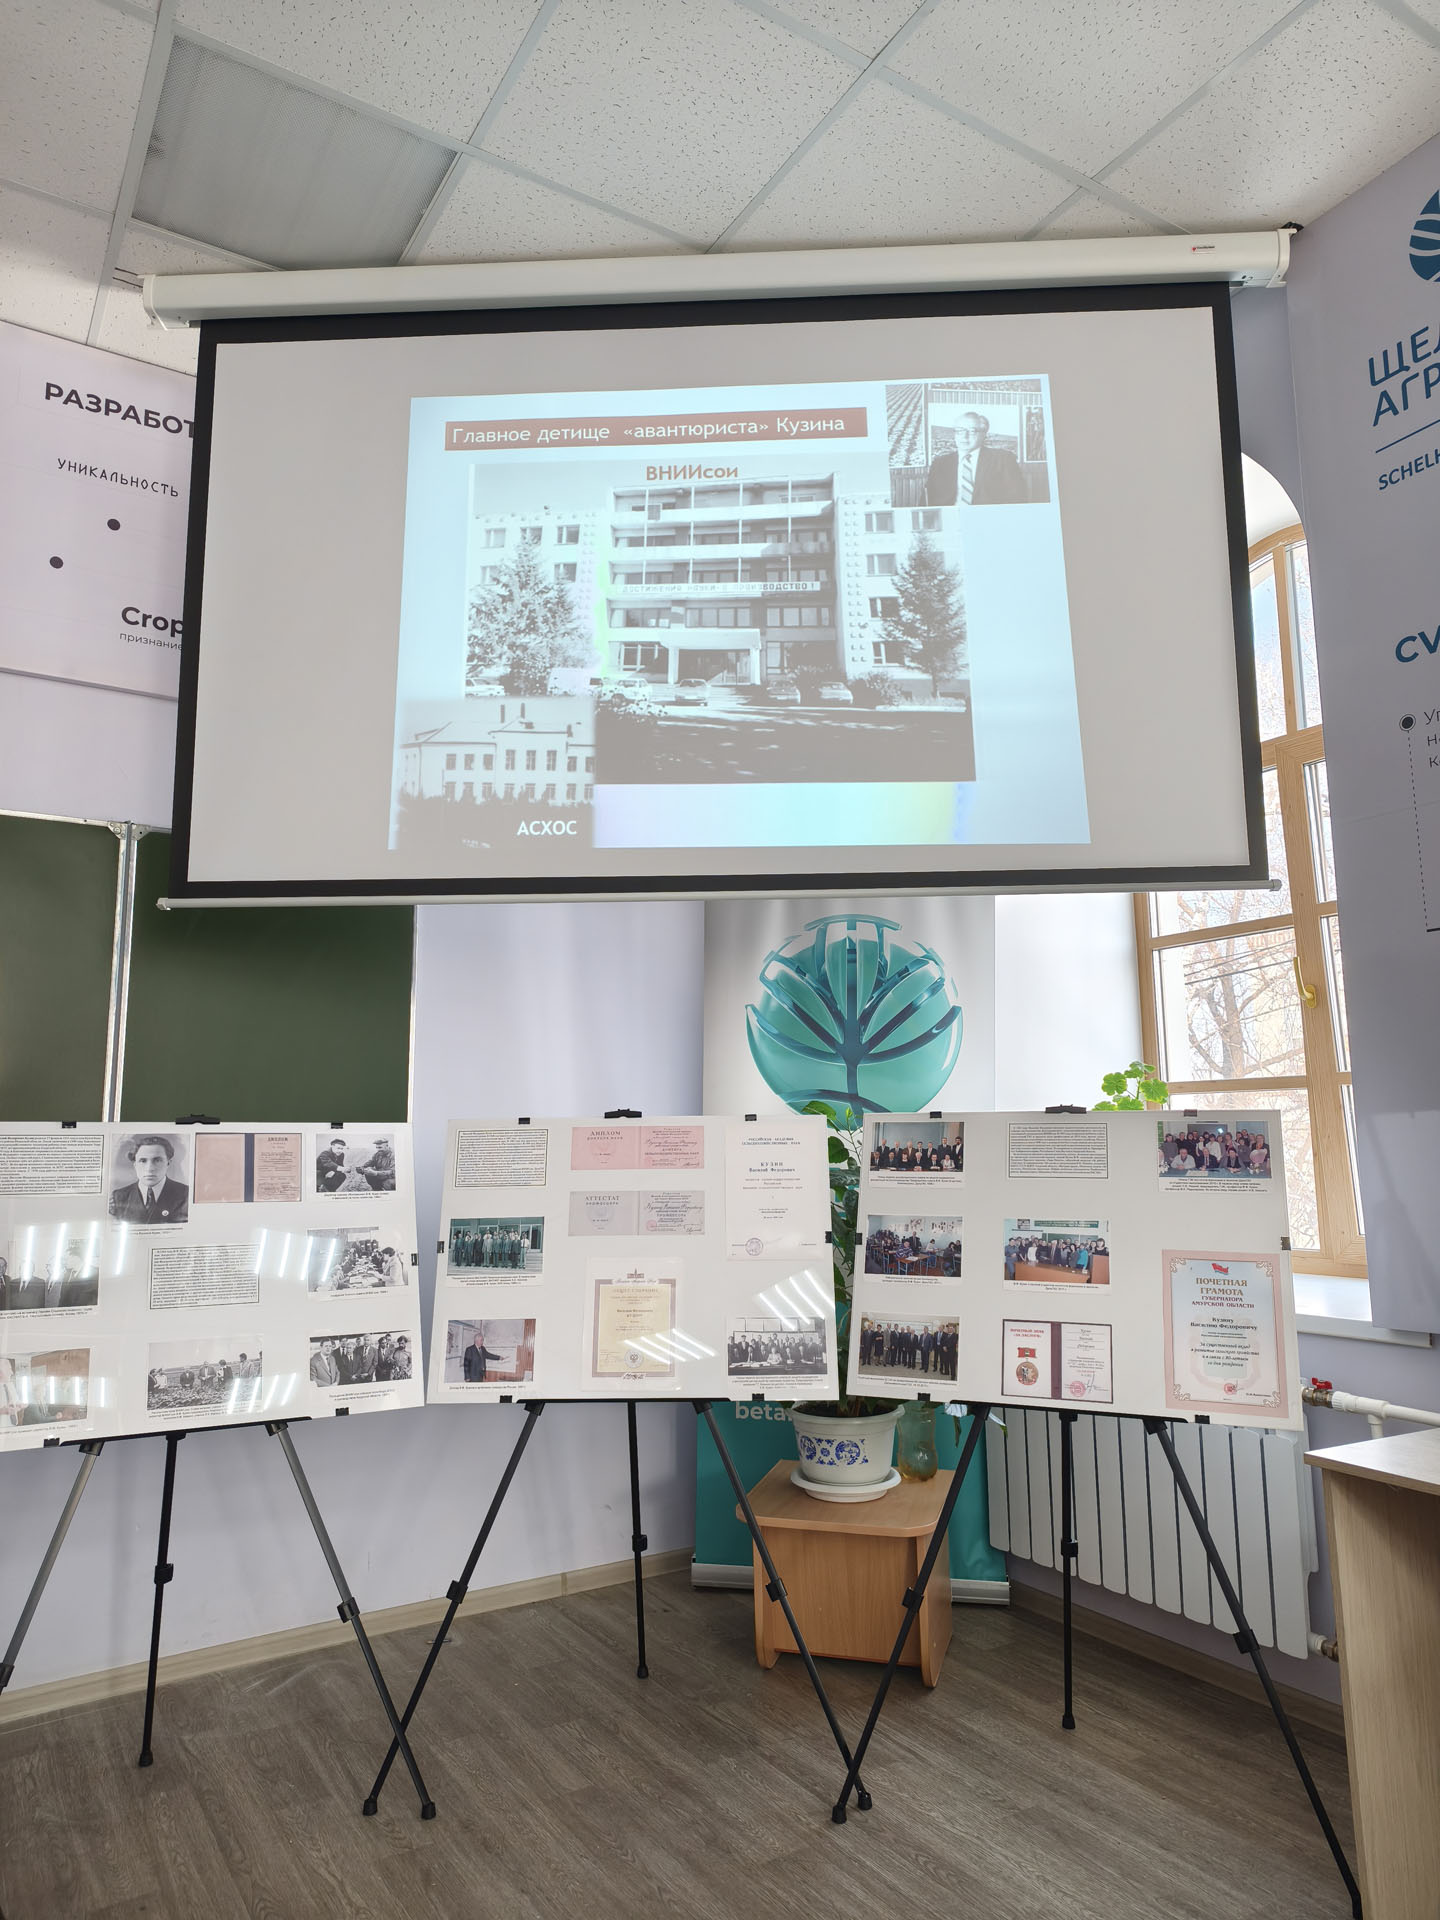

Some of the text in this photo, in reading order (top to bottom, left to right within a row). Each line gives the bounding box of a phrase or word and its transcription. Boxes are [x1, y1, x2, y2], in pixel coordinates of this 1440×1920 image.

[453, 417, 846, 443] Главное детище «авантюриста» Кузина
[57, 458, 179, 497] УНИКАЛЬНОСТЬ
[646, 464, 739, 481] ВНИИсои
[517, 820, 577, 836] АСХОС
[1196, 1277, 1248, 1287] ПОЧЕТНАЯ
[1200, 1287, 1244, 1296] ГРАМОТА
[735, 1400, 792, 1421] beta
